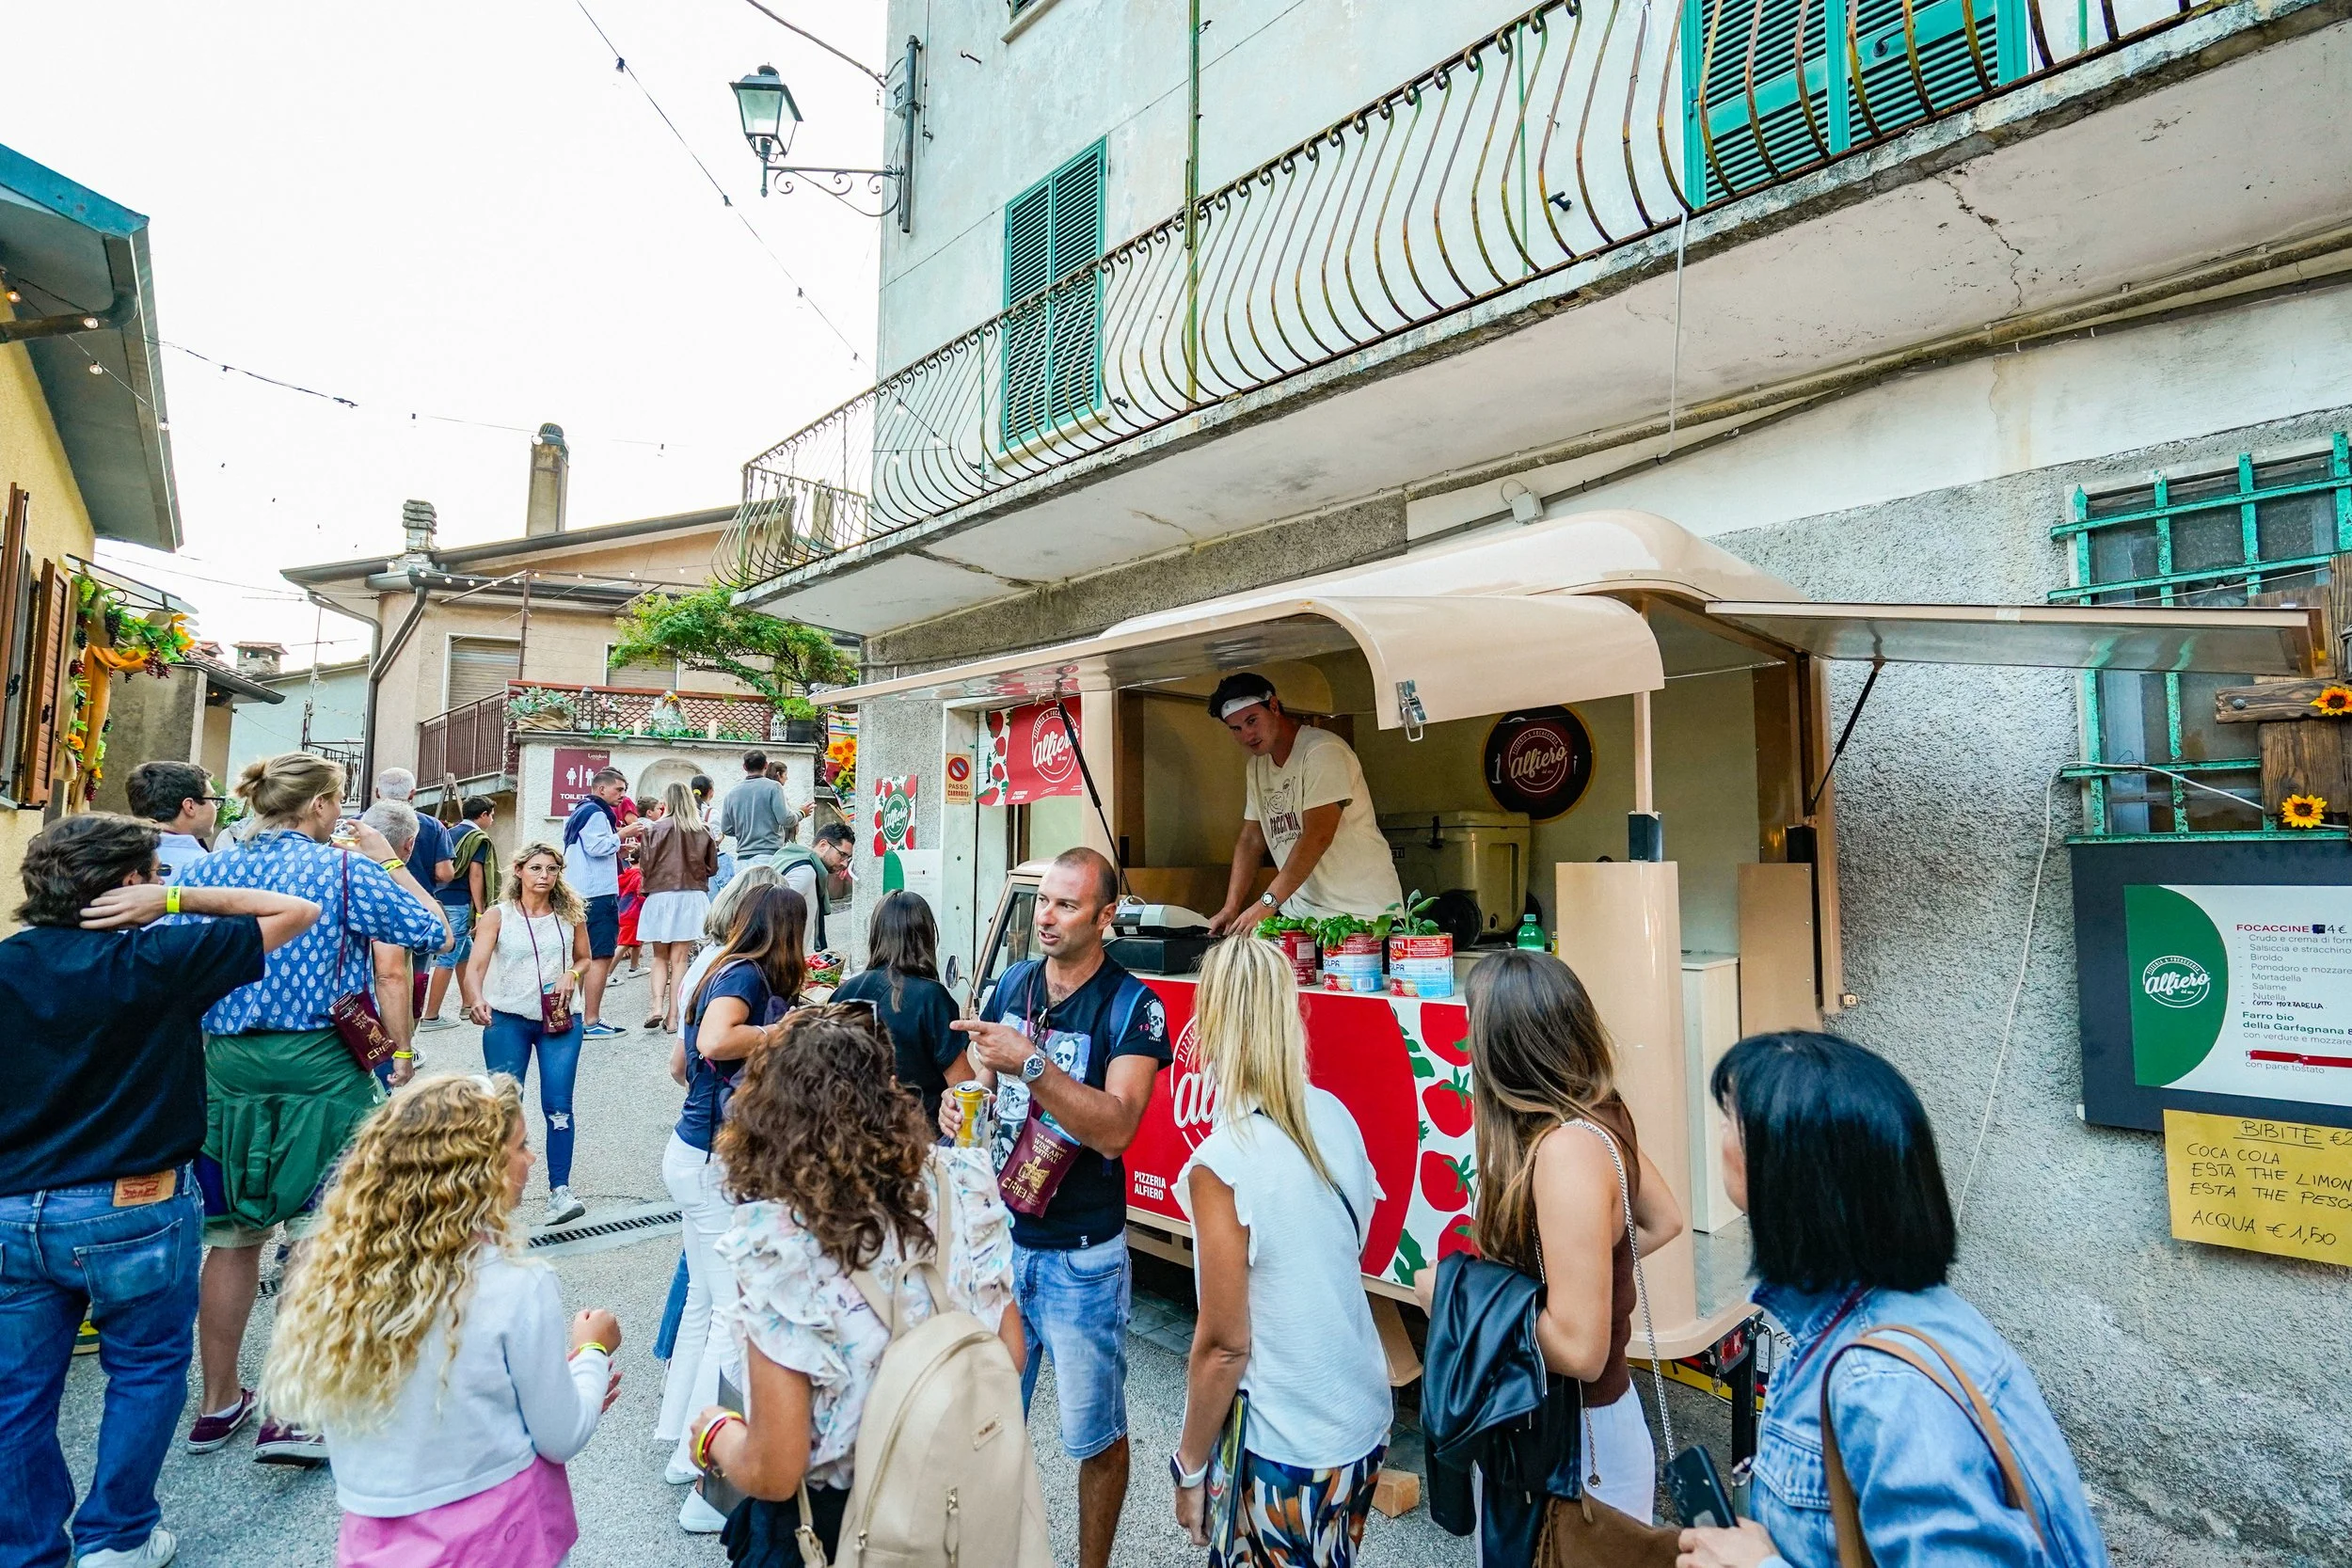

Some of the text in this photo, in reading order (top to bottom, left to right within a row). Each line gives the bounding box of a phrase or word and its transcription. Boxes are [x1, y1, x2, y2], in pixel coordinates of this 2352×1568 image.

[2236, 924, 2310, 933] FOCACCINE
[2249, 943, 2290, 952] Salsiccia
[2301, 945, 2352, 955] stracchino
[2250, 953, 2283, 961] Biroldo
[2250, 963, 2300, 972] Pomodoro
[2251, 973, 2302, 982] Mortadella
[2252, 982, 2287, 990] Salame
[2252, 992, 2286, 1001] Nutella
[2242, 1011, 2295, 1022] Farro bio
[2243, 1022, 2270, 1030] della
[2274, 1022, 2344, 1036] Garfagnana
[2264, 1034, 2299, 1042] verdure
[2265, 1063, 2289, 1072] pane
[2292, 1065, 2325, 1074] tostato
[2241, 1120, 2323, 1145] BIBITE
[1031, 1144, 1057, 1164] FESTIVAL
[1034, 1137, 1064, 1160] WINE ART
[2186, 1143, 2280, 1164] COCA COLA
[2191, 1163, 2236, 1178] ESTA
[2246, 1167, 2288, 1180] THE
[1134, 1170, 1167, 1190] PIZZERIA
[1134, 1182, 1164, 1201] ALFIERO
[2189, 1182, 2236, 1197] ESTA
[2251, 1187, 2288, 1201] THE
[2191, 1210, 2256, 1234] ACQUA
